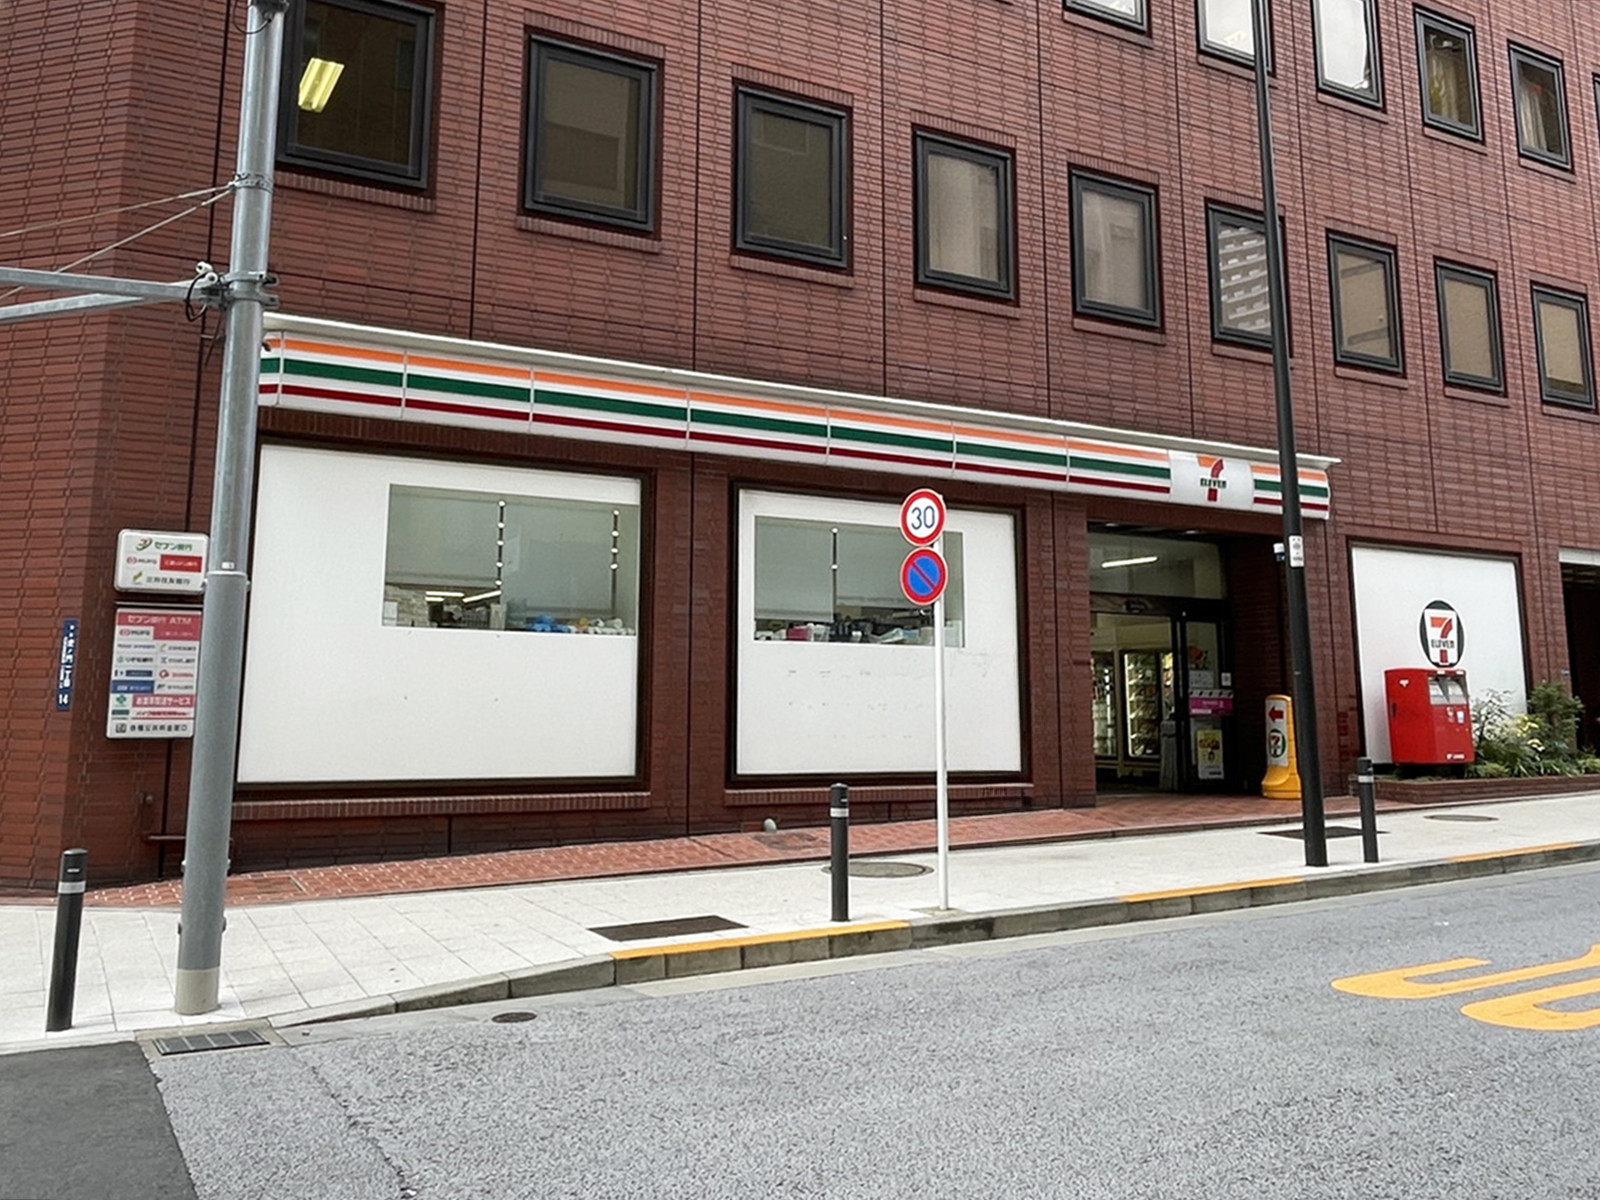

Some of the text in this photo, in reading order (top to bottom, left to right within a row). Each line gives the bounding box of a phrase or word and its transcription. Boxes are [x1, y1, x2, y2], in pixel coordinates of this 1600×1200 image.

[1200, 478, 1226, 489] ELEVEN
[911, 505, 935, 530] 30
[169, 617, 192, 625] ATM
[1430, 639, 1455, 649] ELEVEN
